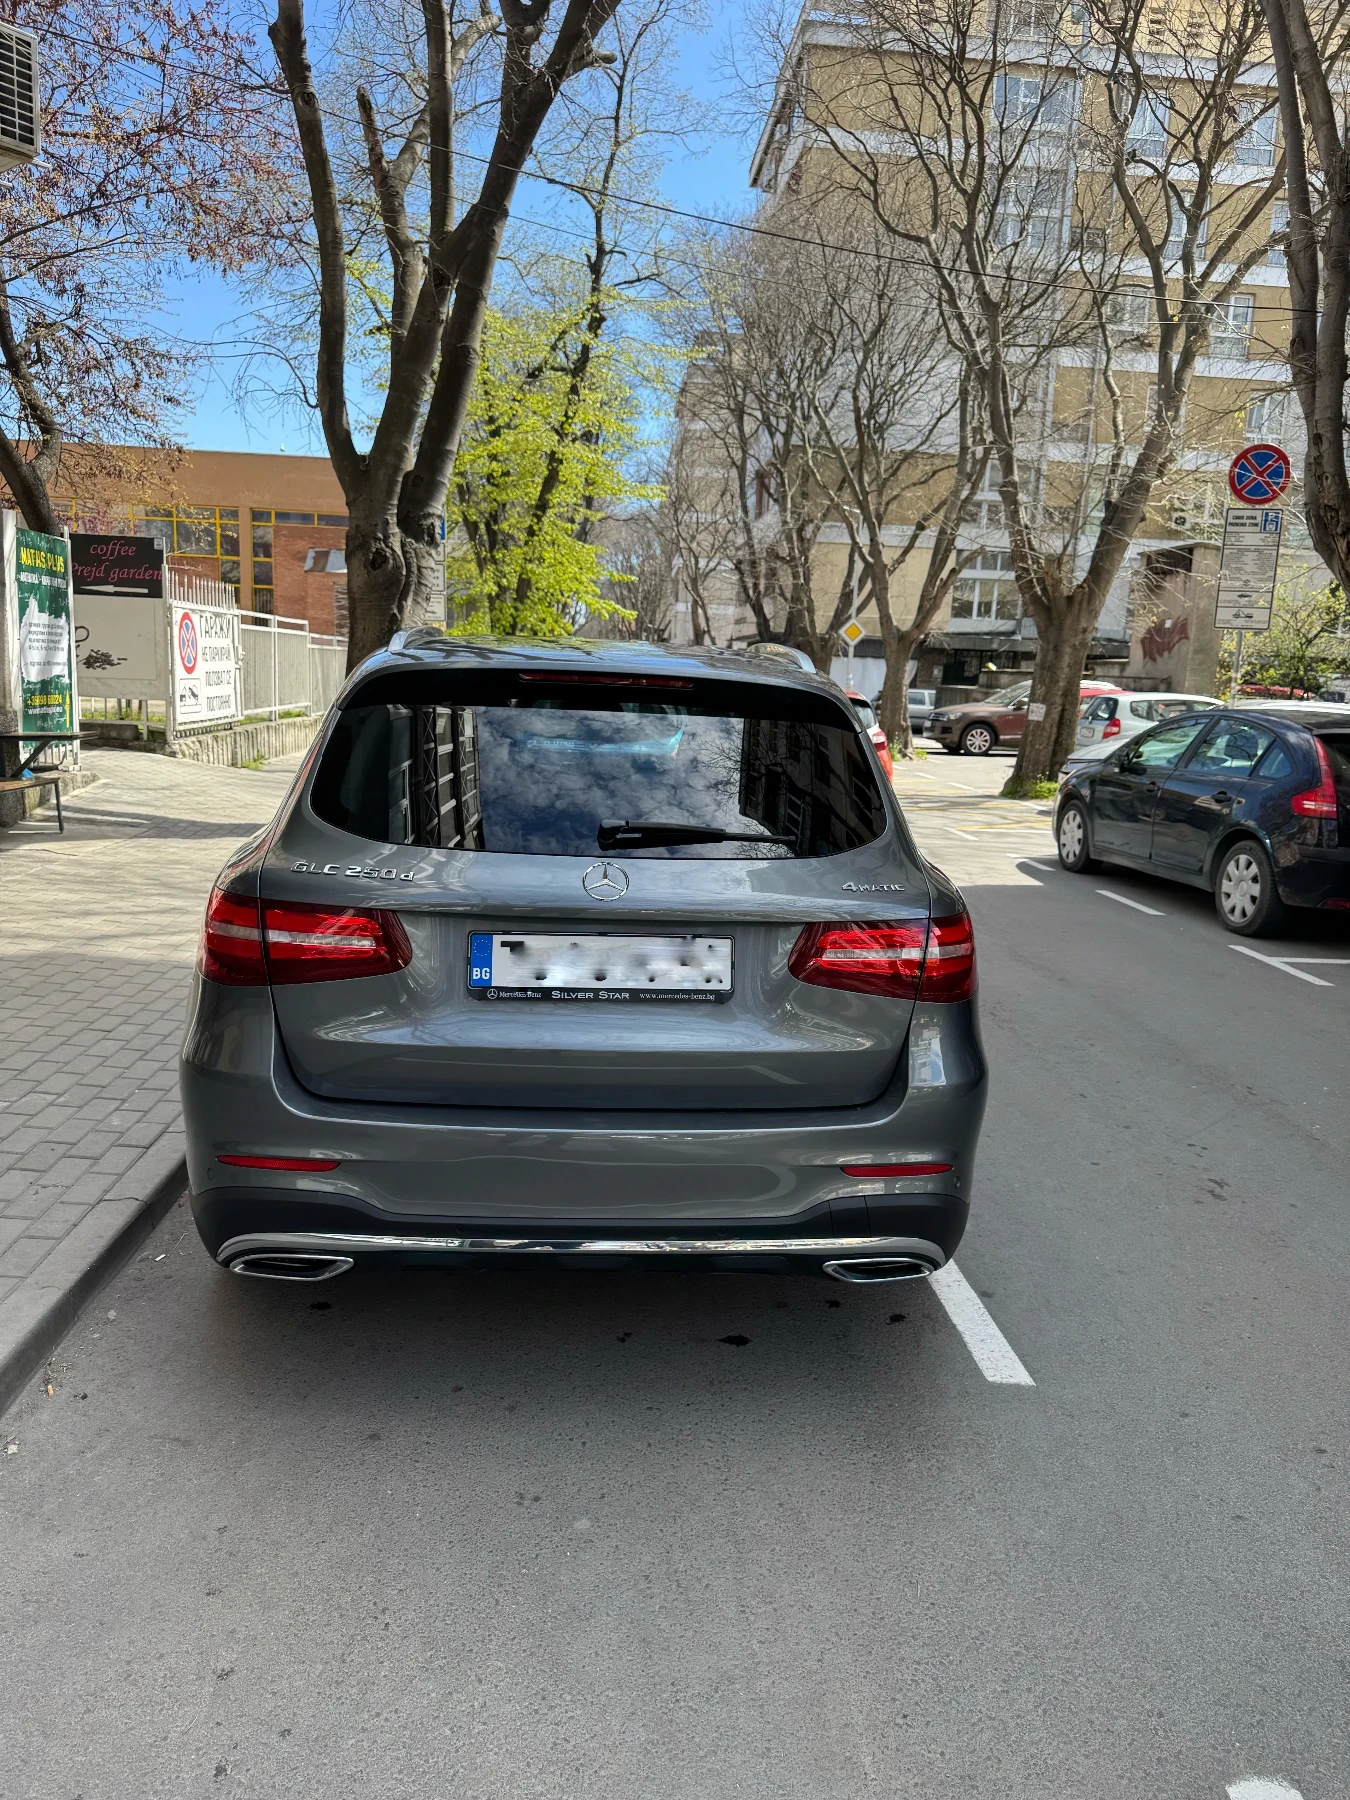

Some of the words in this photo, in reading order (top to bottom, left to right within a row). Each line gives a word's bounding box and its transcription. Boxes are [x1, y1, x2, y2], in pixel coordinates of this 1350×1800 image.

[90, 540, 136, 559] coffee
[109, 564, 162, 582] garden
[200, 615, 231, 638] ГАРАЖИ
[291, 861, 340, 876] GLC
[344, 865, 397, 879] 250
[842, 881, 905, 893] 4MATIC
[472, 967, 491, 980] BG
[639, 992, 716, 1001] www.mercedes-benz.bg
